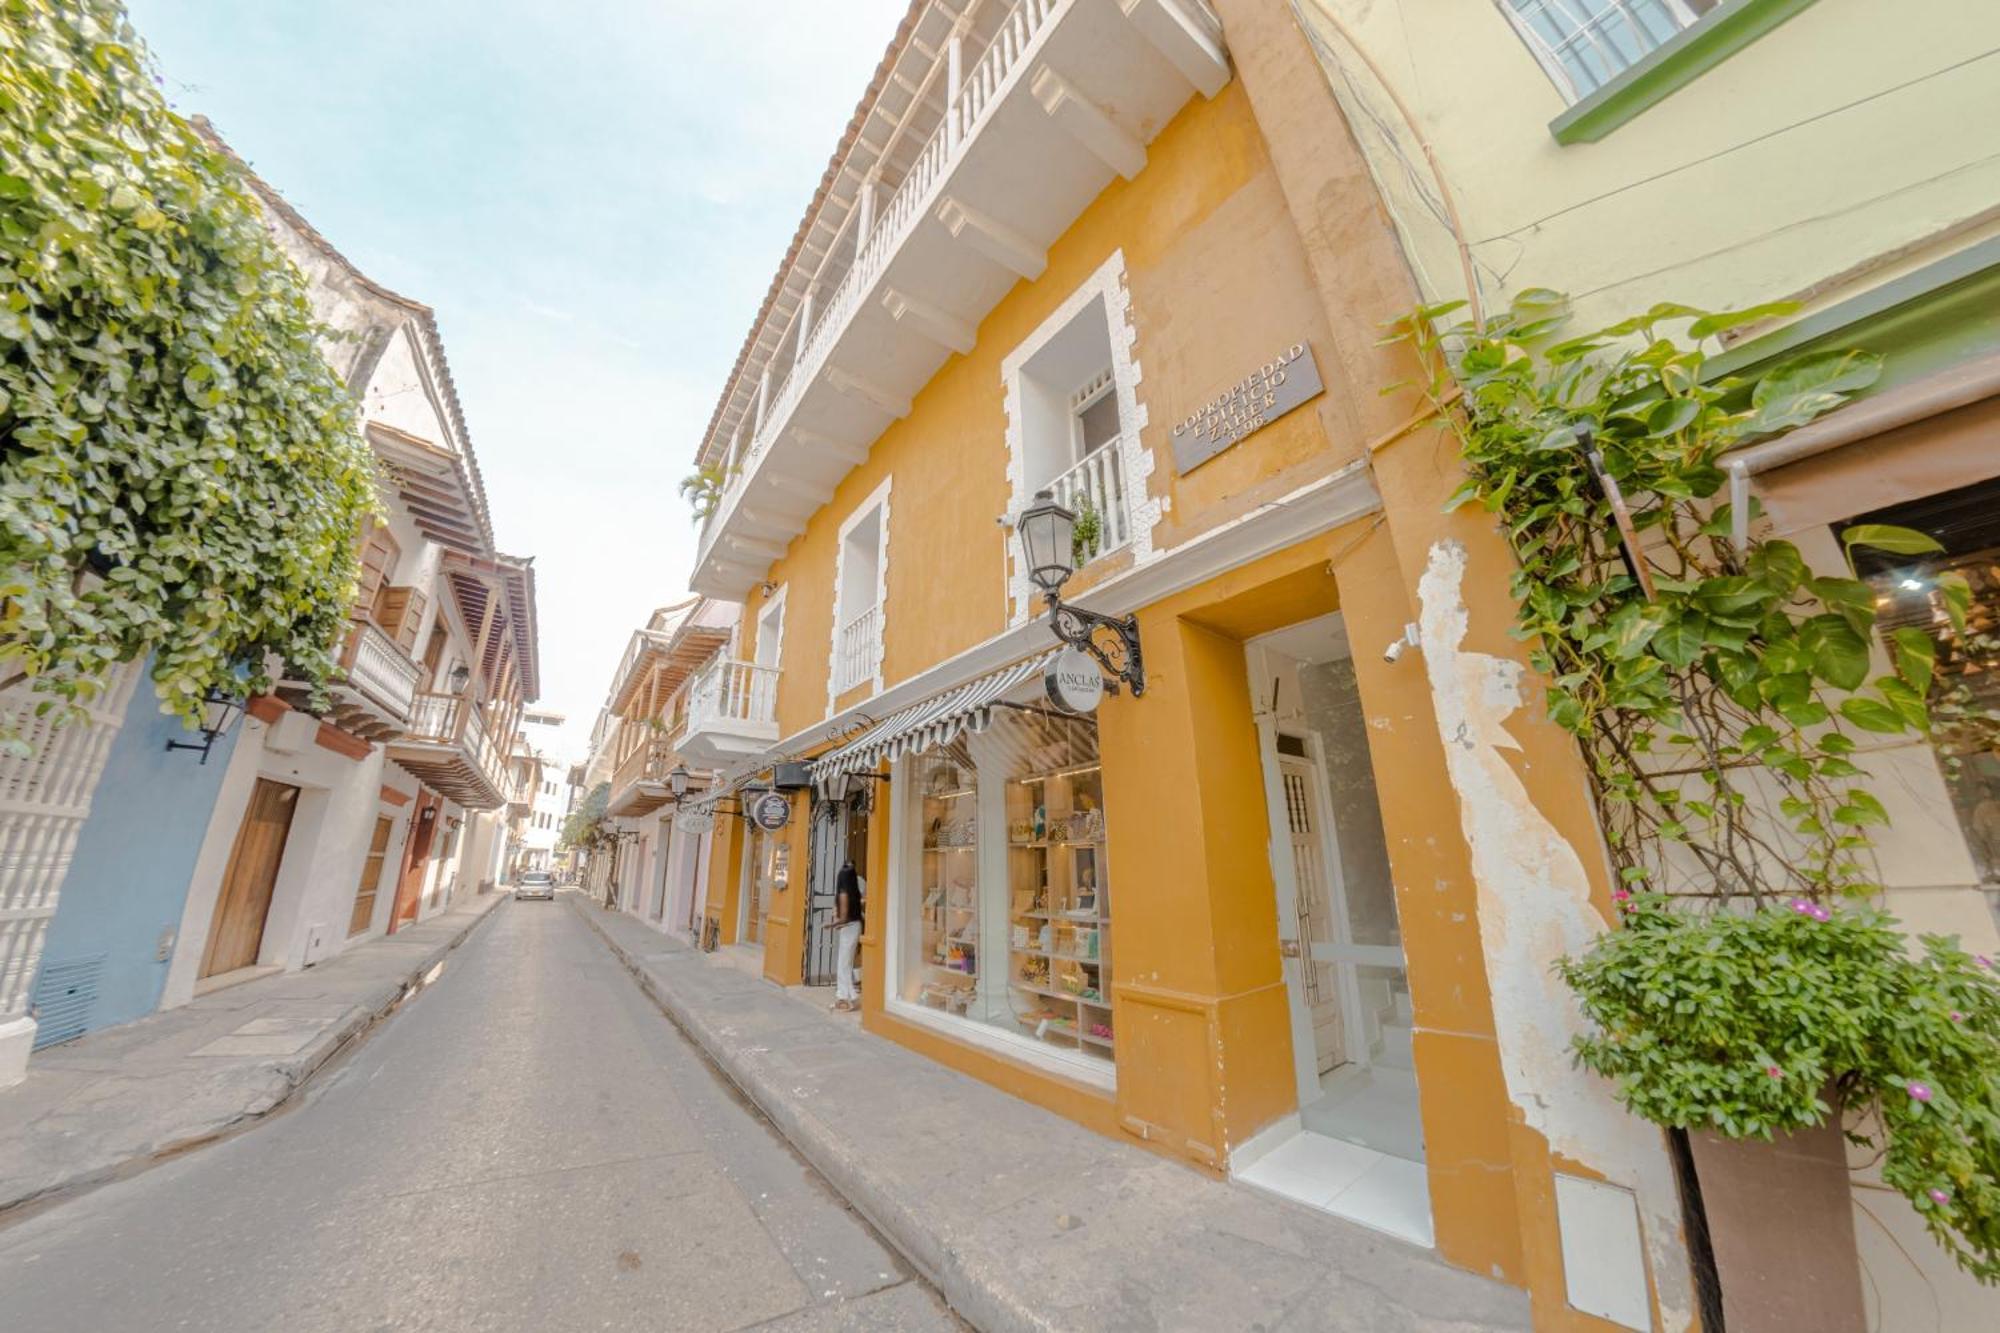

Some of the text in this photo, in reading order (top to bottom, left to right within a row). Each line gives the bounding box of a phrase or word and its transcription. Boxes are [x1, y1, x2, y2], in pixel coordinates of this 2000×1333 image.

[1173, 344, 1305, 437] COPROPIEDAD
[1195, 371, 1286, 438] EDIFICIO
[1210, 393, 1276, 442] ZAHER
[1059, 672, 1100, 687] ANCLAS
